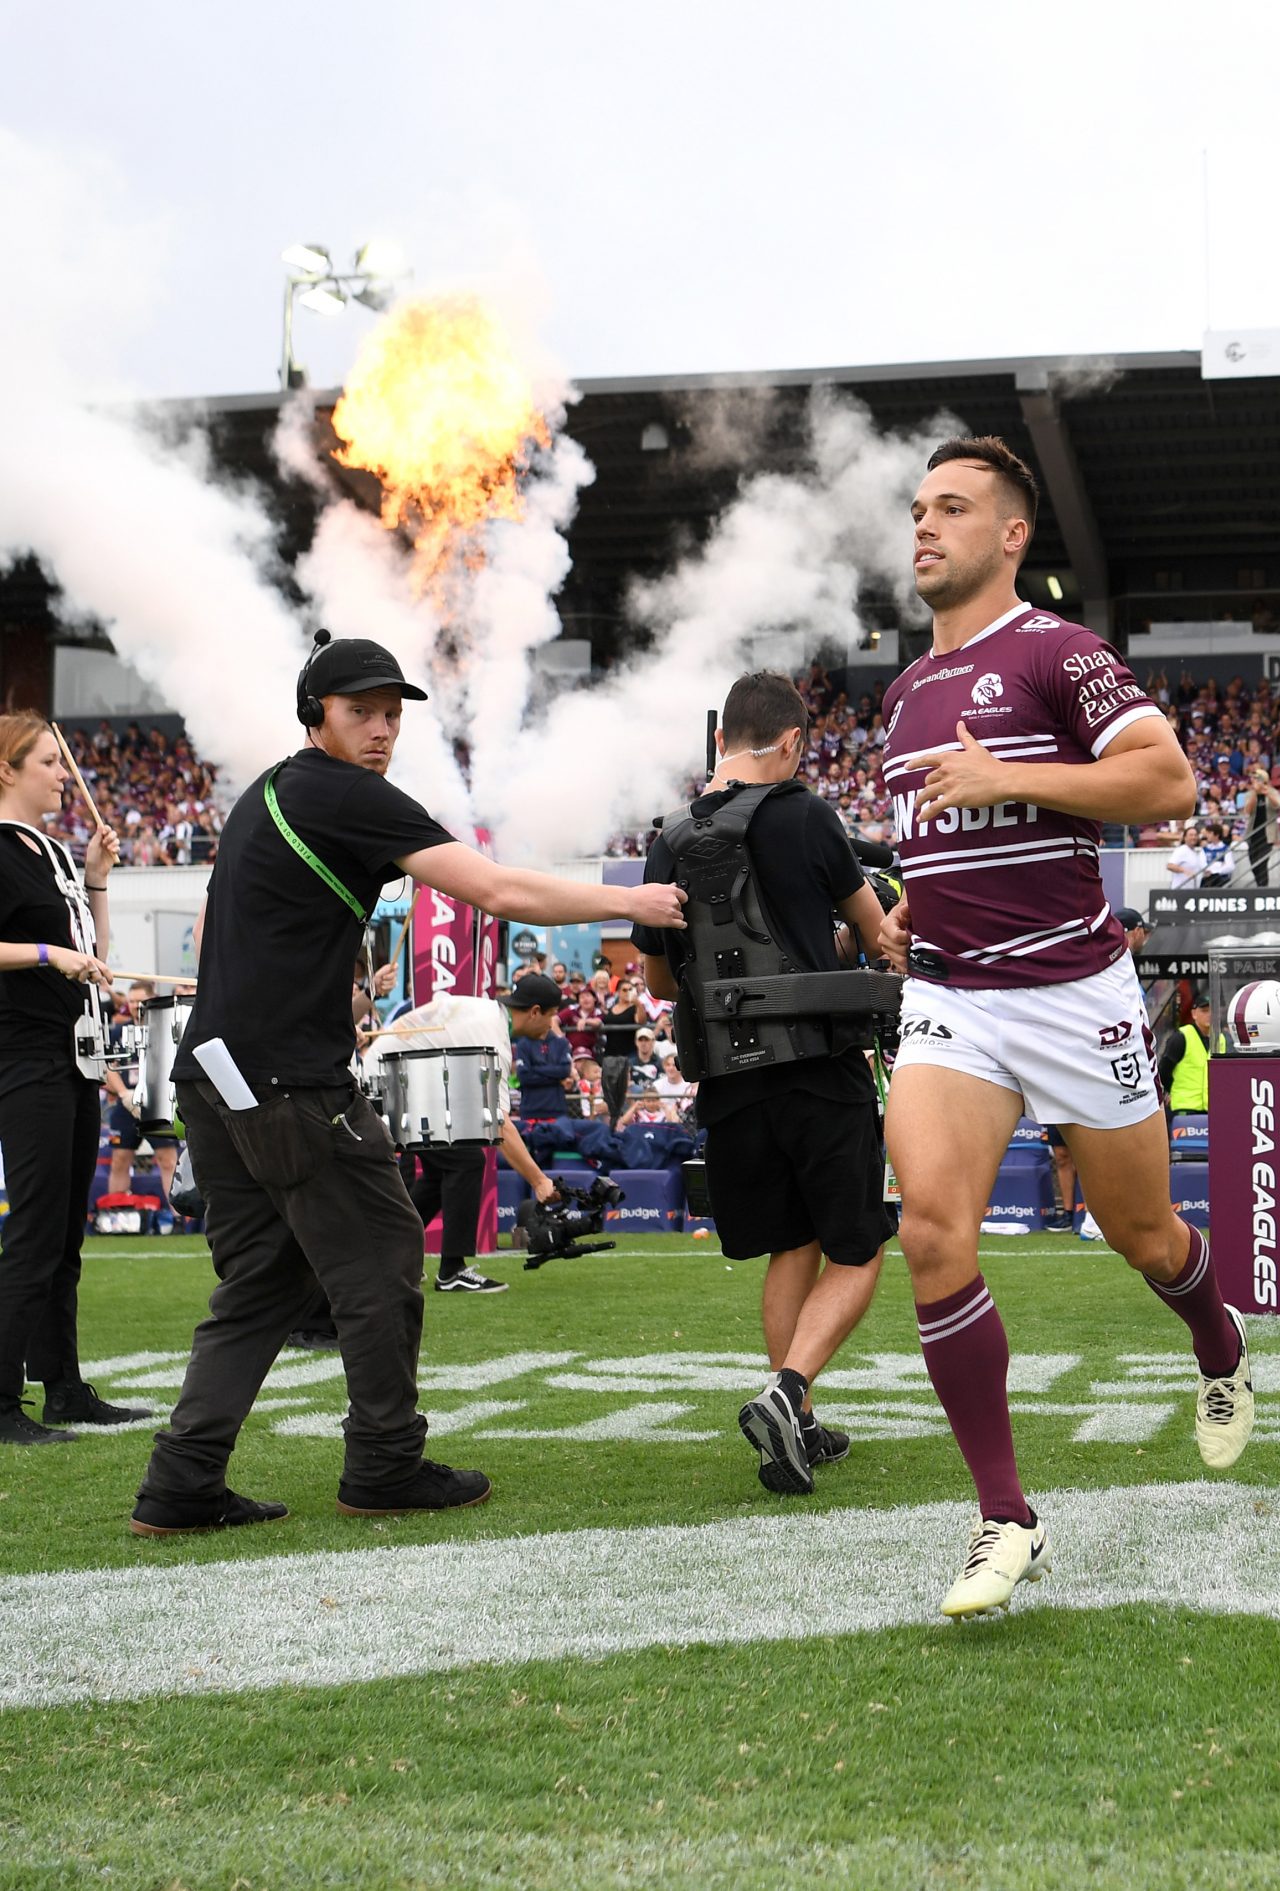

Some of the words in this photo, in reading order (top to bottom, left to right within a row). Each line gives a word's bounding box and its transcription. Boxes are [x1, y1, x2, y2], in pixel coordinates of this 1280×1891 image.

[1063, 650, 1118, 681] Shaw
[1079, 667, 1119, 703] and
[960, 709, 977, 717] SEA
[977, 706, 1013, 715] EAGLES
[1184, 898, 1196, 912] 4
[1199, 897, 1247, 913] PINES
[1167, 961, 1179, 974] 4
[1250, 1077, 1275, 1156] SEA
[620, 1207, 662, 1220] Budget
[992, 1204, 1035, 1218] Budget
[1251, 1160, 1278, 1308] EAGLES
